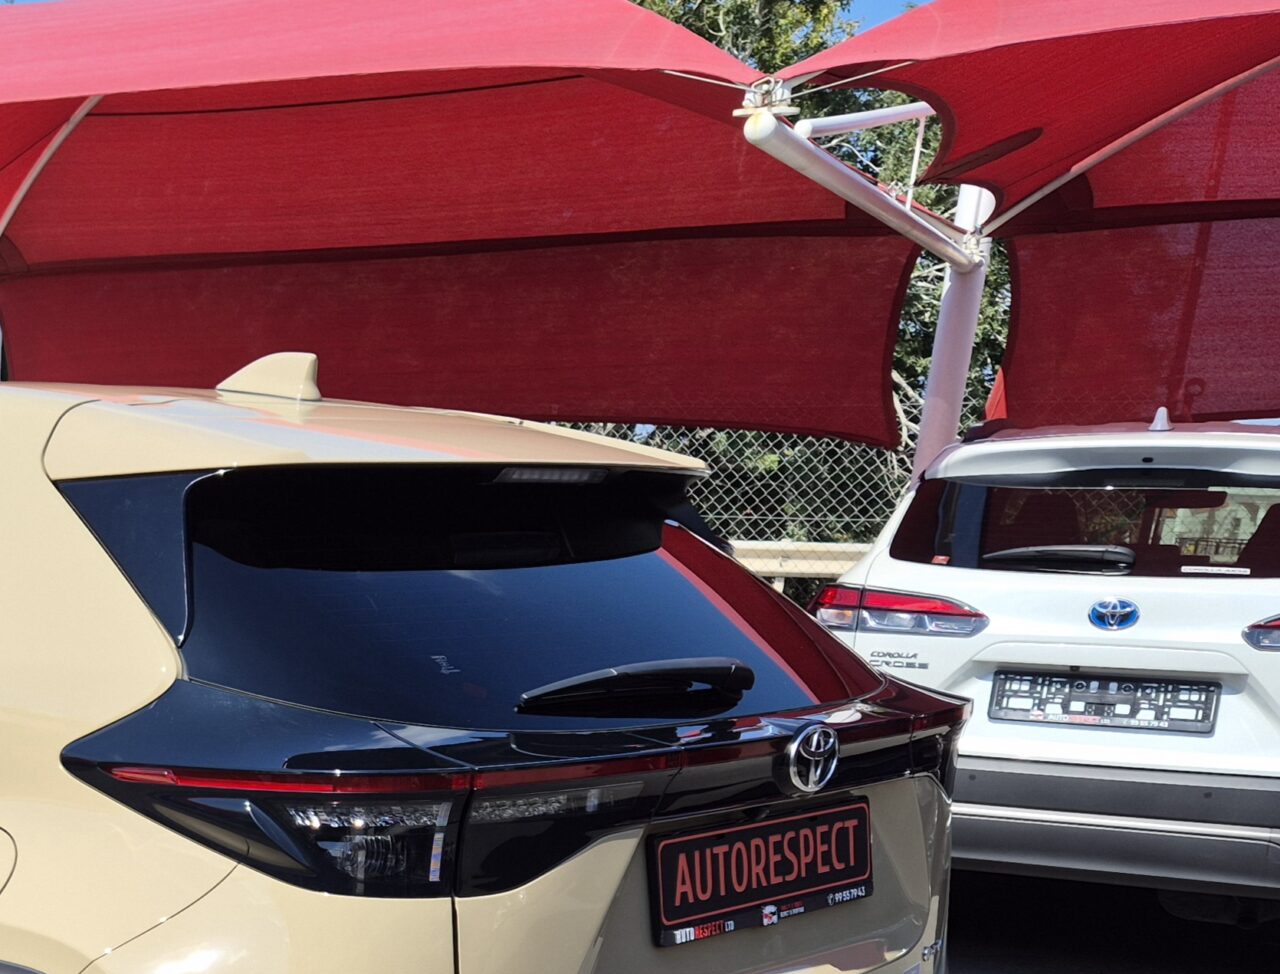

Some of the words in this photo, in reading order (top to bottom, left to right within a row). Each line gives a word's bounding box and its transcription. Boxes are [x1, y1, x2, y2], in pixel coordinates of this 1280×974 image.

[870, 650, 919, 659] COROLLA
[869, 659, 929, 670] CROSS
[674, 819, 859, 906] AUTORESPECT
